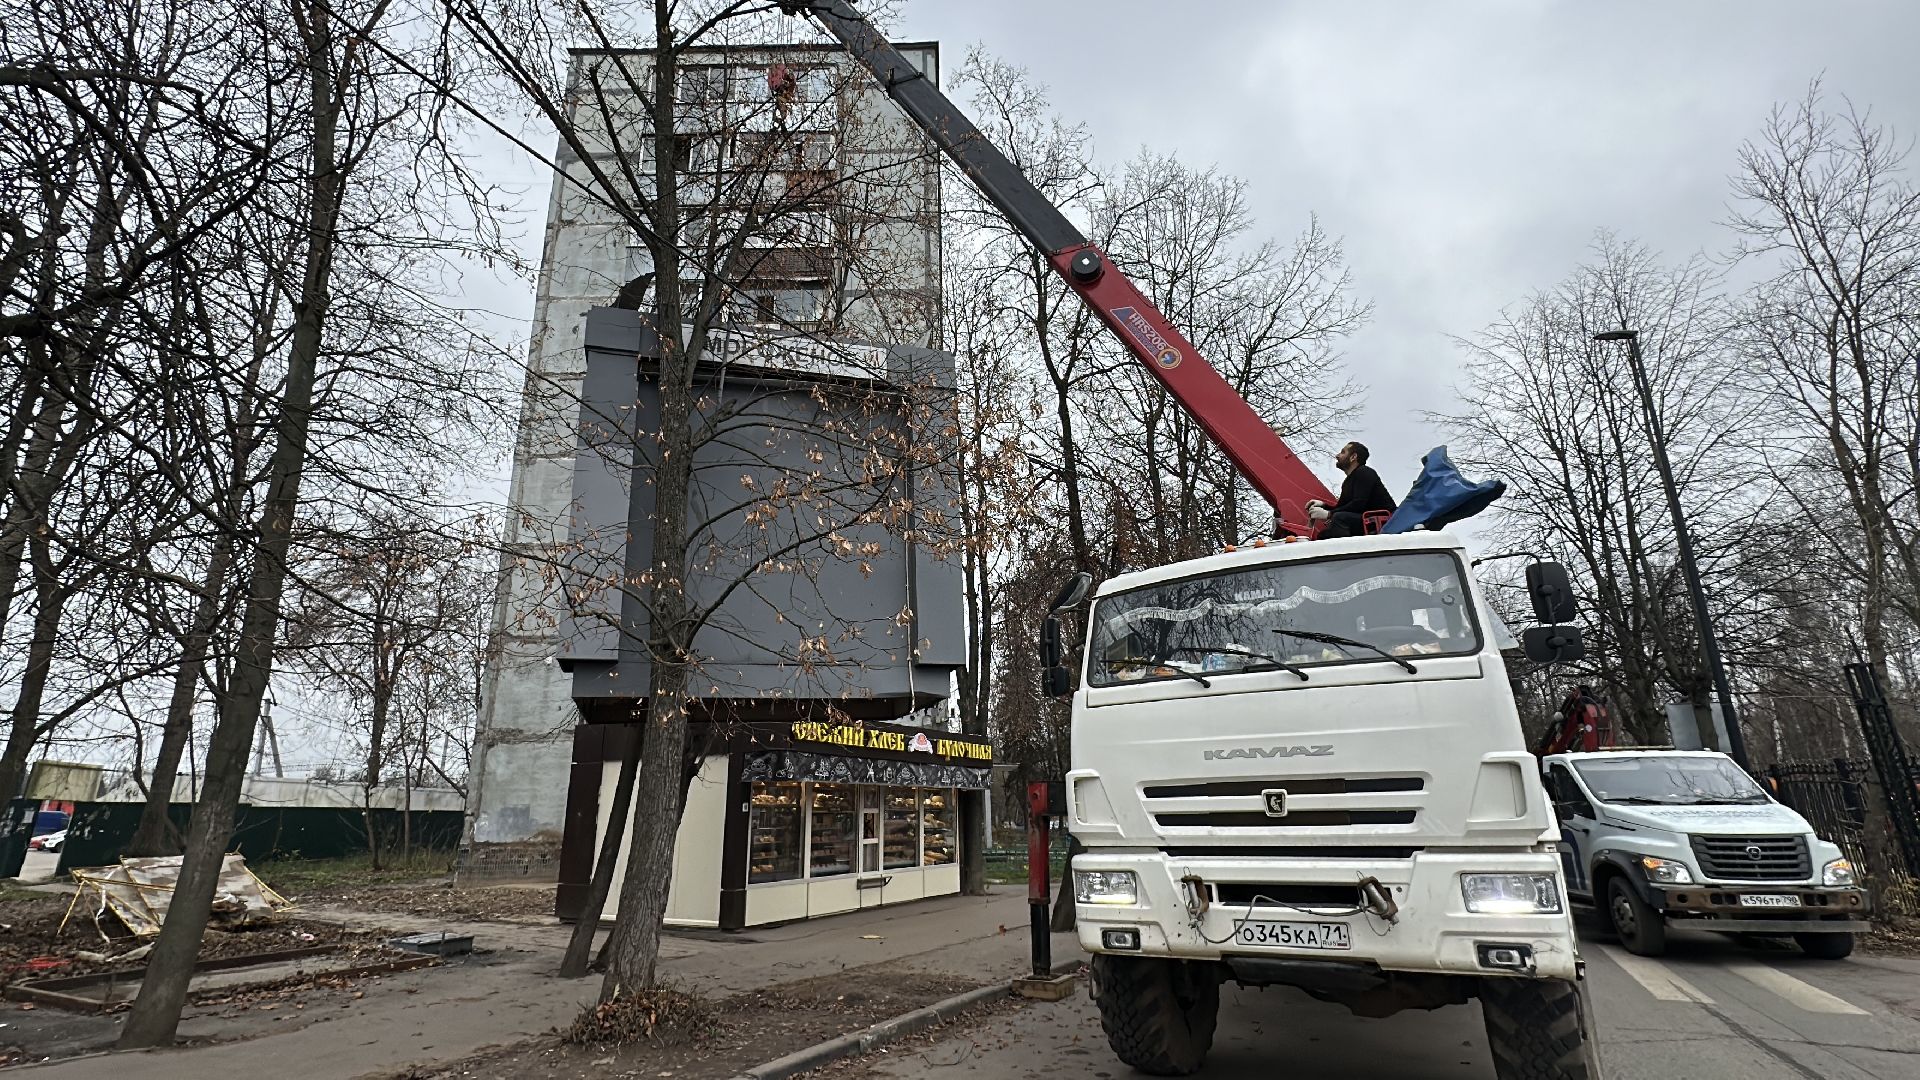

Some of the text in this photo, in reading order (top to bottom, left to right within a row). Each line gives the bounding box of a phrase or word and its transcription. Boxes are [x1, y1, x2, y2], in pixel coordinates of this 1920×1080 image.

[1128, 312, 1167, 351] HRS206
[867, 729, 905, 751] ХЛЕБ
[936, 739, 992, 761] БУЛОЧНАЯ
[1203, 744, 1335, 761] KAMAZ
[1321, 925, 1343, 941] 71
